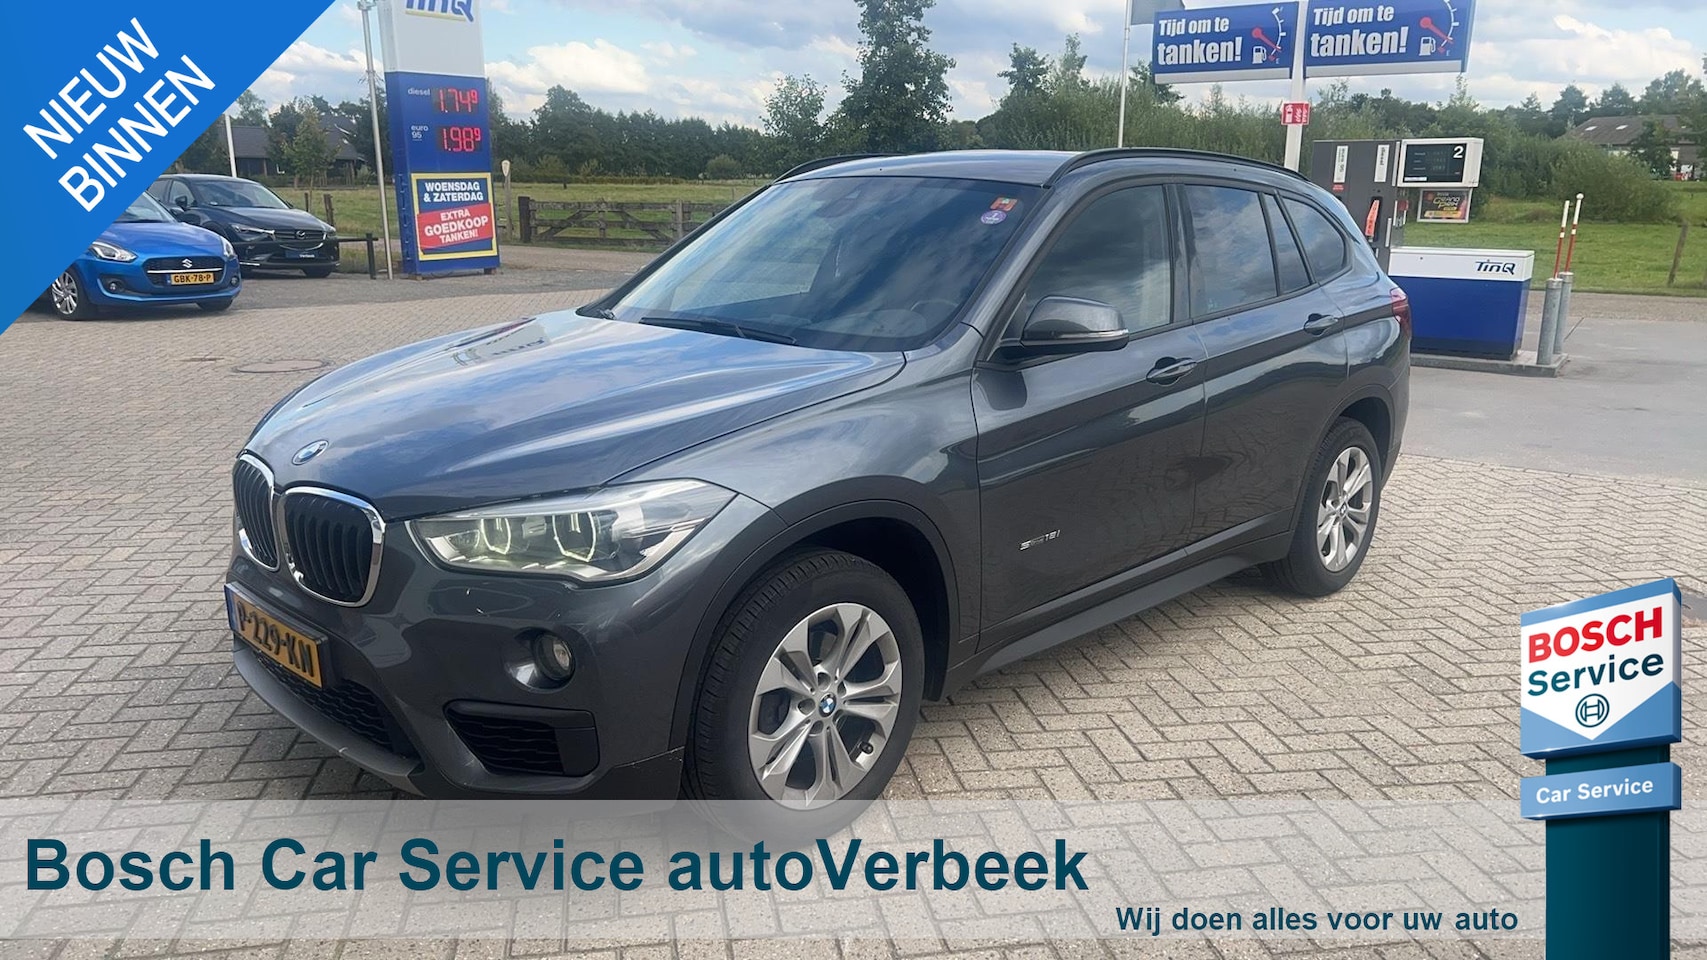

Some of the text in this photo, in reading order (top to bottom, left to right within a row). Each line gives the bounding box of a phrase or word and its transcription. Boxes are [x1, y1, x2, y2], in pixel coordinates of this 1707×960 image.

[1313, 5, 1395, 27] Tijd om te
[1158, 16, 1230, 37] Tijd om te
[1310, 26, 1410, 57] tanken!
[1157, 36, 1243, 66] tanken!
[407, 88, 431, 96] diesel
[411, 131, 422, 139] 95
[1453, 145, 1464, 159] 2
[425, 181, 480, 192] WOENSDAG
[423, 192, 484, 202] & ZATERDAG
[440, 208, 471, 221] EXTRA
[424, 215, 489, 236] GOEDKOOP
[439, 229, 478, 244] TANKEN!
[1475, 259, 1516, 275] TinQ
